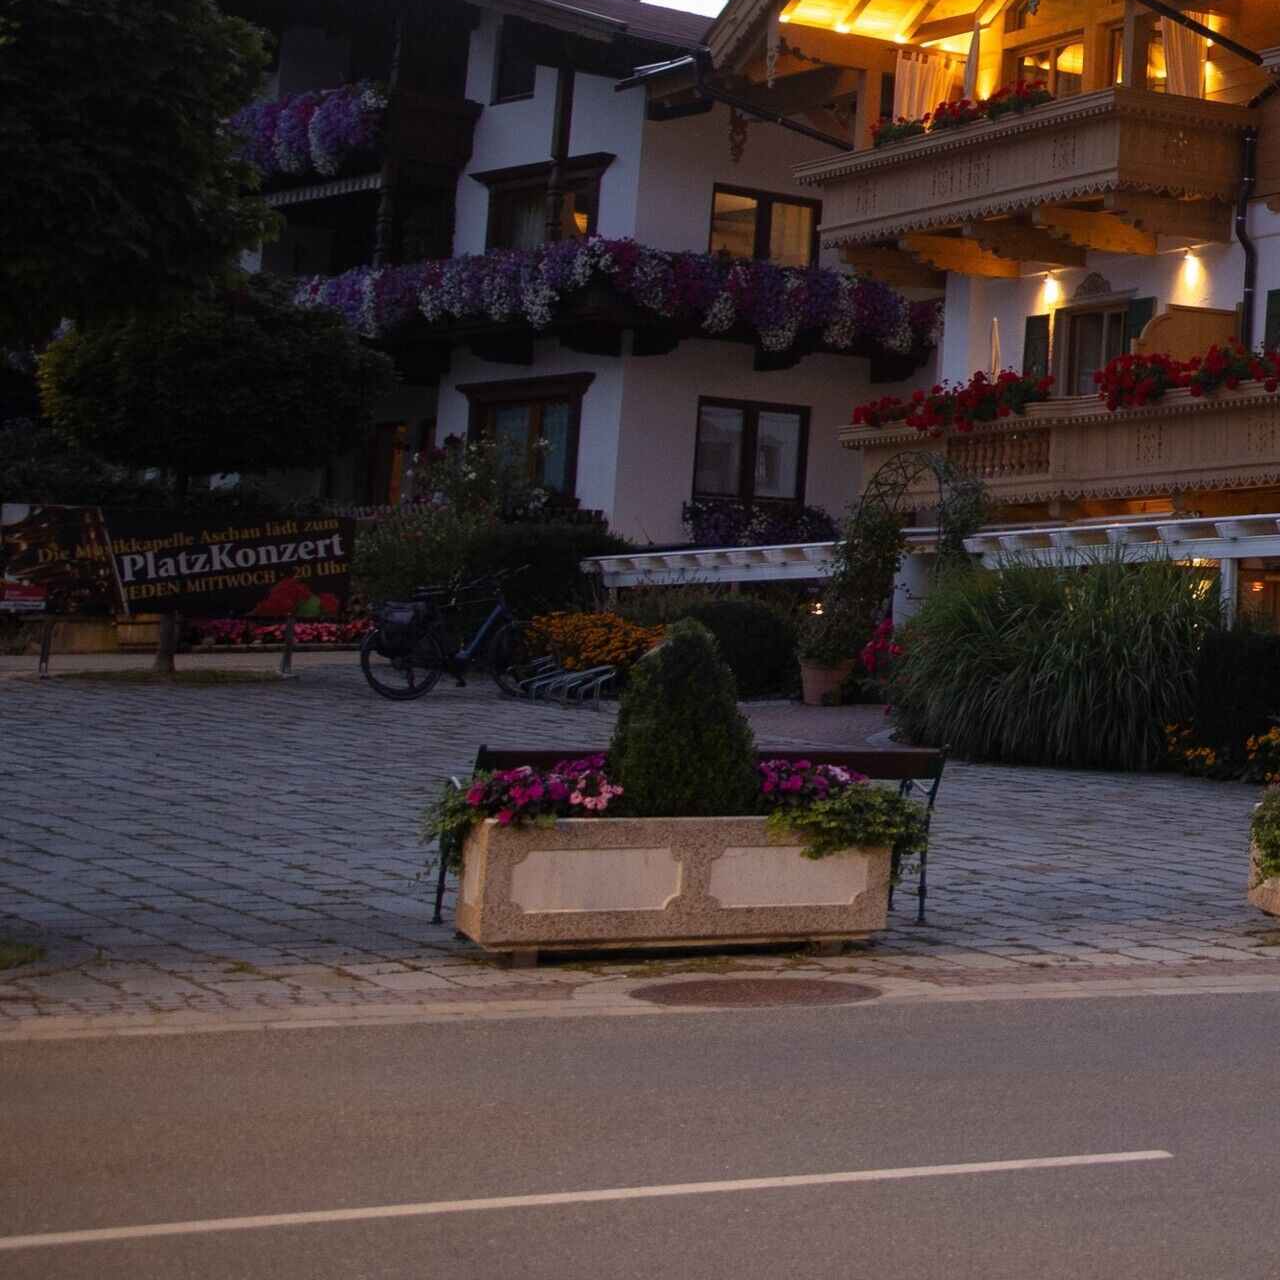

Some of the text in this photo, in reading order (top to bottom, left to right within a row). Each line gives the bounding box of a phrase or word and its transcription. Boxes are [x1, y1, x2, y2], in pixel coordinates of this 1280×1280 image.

[38, 544, 70, 563] Die
[200, 526, 260, 545] Aschau
[265, 520, 299, 536] lädt
[304, 518, 341, 532] zum
[121, 533, 346, 582] PlatzKonzert
[122, 580, 181, 600] JEDEN
[187, 570, 276, 593] MITTWOCH
[292, 565, 312, 579] 20
[316, 560, 349, 577] Uhr
